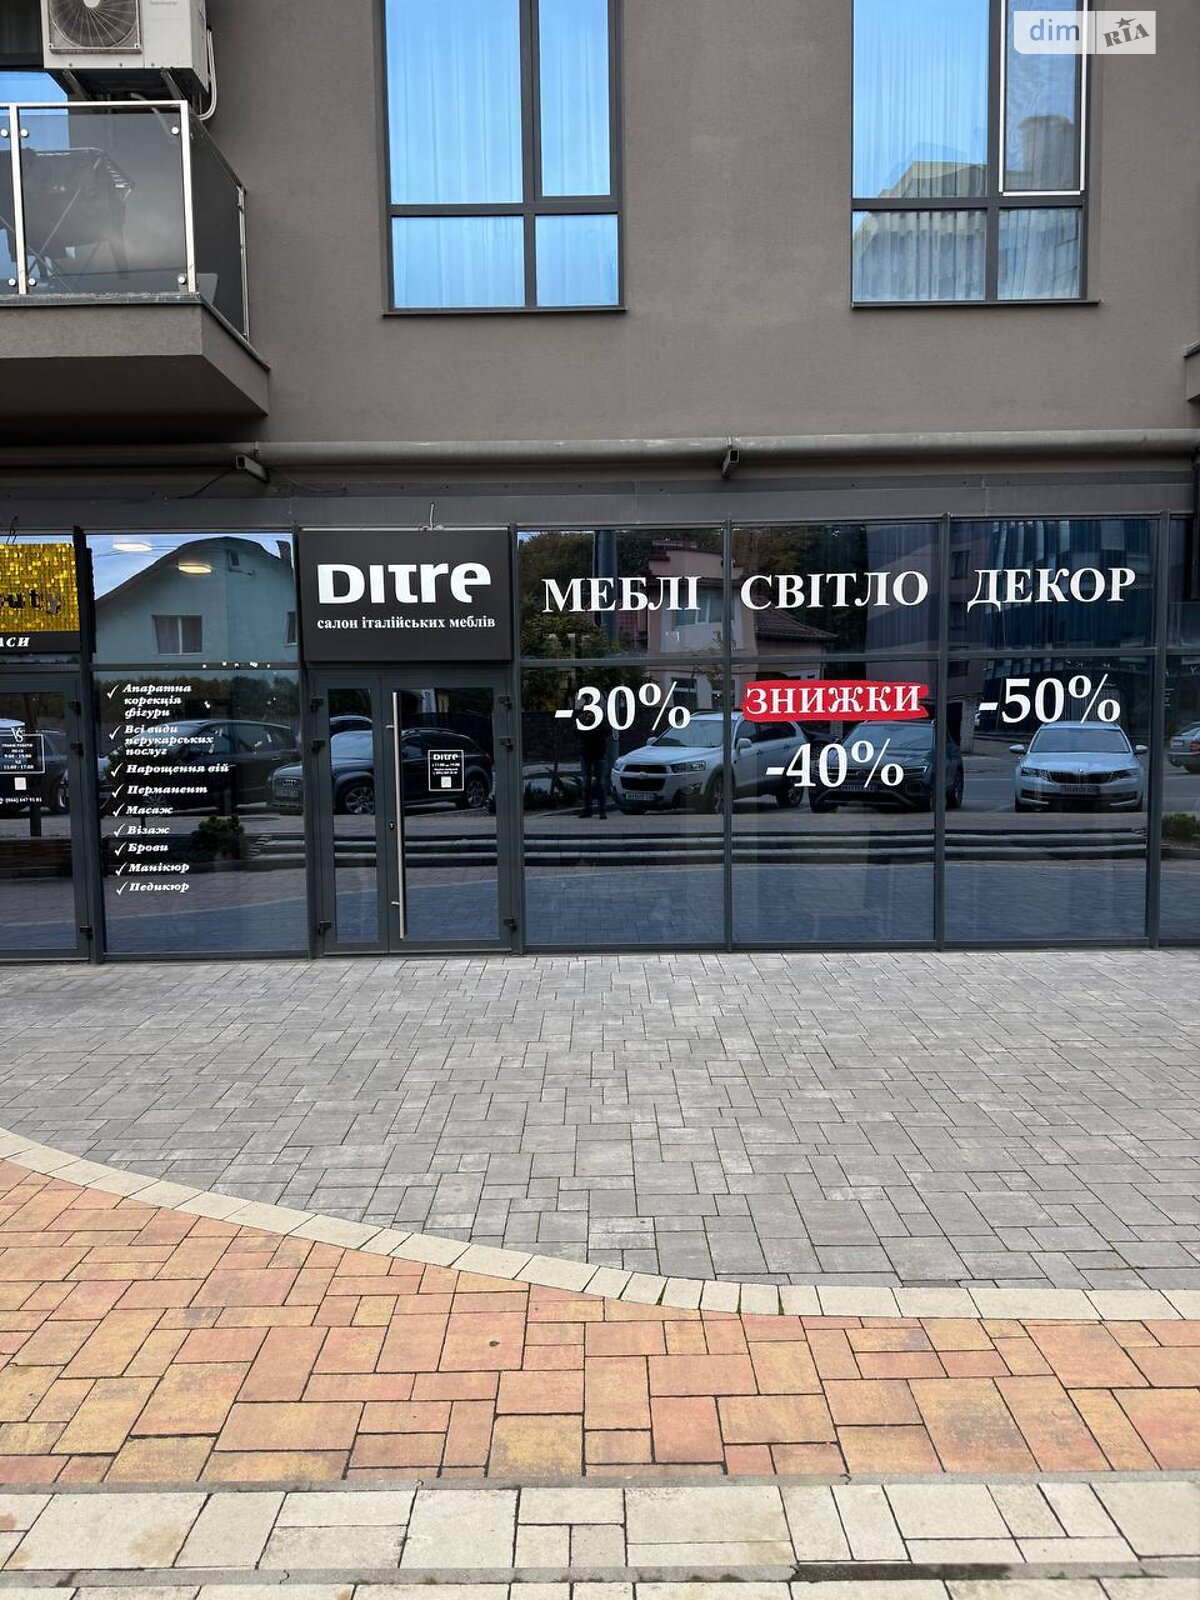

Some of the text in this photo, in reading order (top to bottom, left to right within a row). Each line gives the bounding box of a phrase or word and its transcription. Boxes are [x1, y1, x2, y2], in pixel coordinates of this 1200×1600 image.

[541, 575, 701, 613] МЕБЛІ
[740, 570, 929, 610] СВІТЛО
[967, 567, 1136, 613] ДЕКОР
[317, 615, 496, 629] салон італійських меблів
[122, 683, 192, 695] Апаратна
[124, 695, 182, 707] корекція
[746, 684, 922, 714] ЗНИЖКИ
[978, 673, 1121, 724] -50%
[554, 681, 691, 731] -30%
[124, 707, 170, 719] фігури
[124, 724, 178, 734] Всі види
[125, 736, 214, 747] перукарських
[125, 747, 167, 757] послуг
[126, 763, 229, 775] Нарощення вій
[765, 738, 904, 789] -40%
[127, 785, 208, 796] Перманент
[125, 805, 173, 815] Масаж
[127, 825, 170, 835] Візаж
[127, 843, 169, 854] Брови
[128, 862, 190, 873] Манікюр
[129, 882, 190, 893] Педикюр
